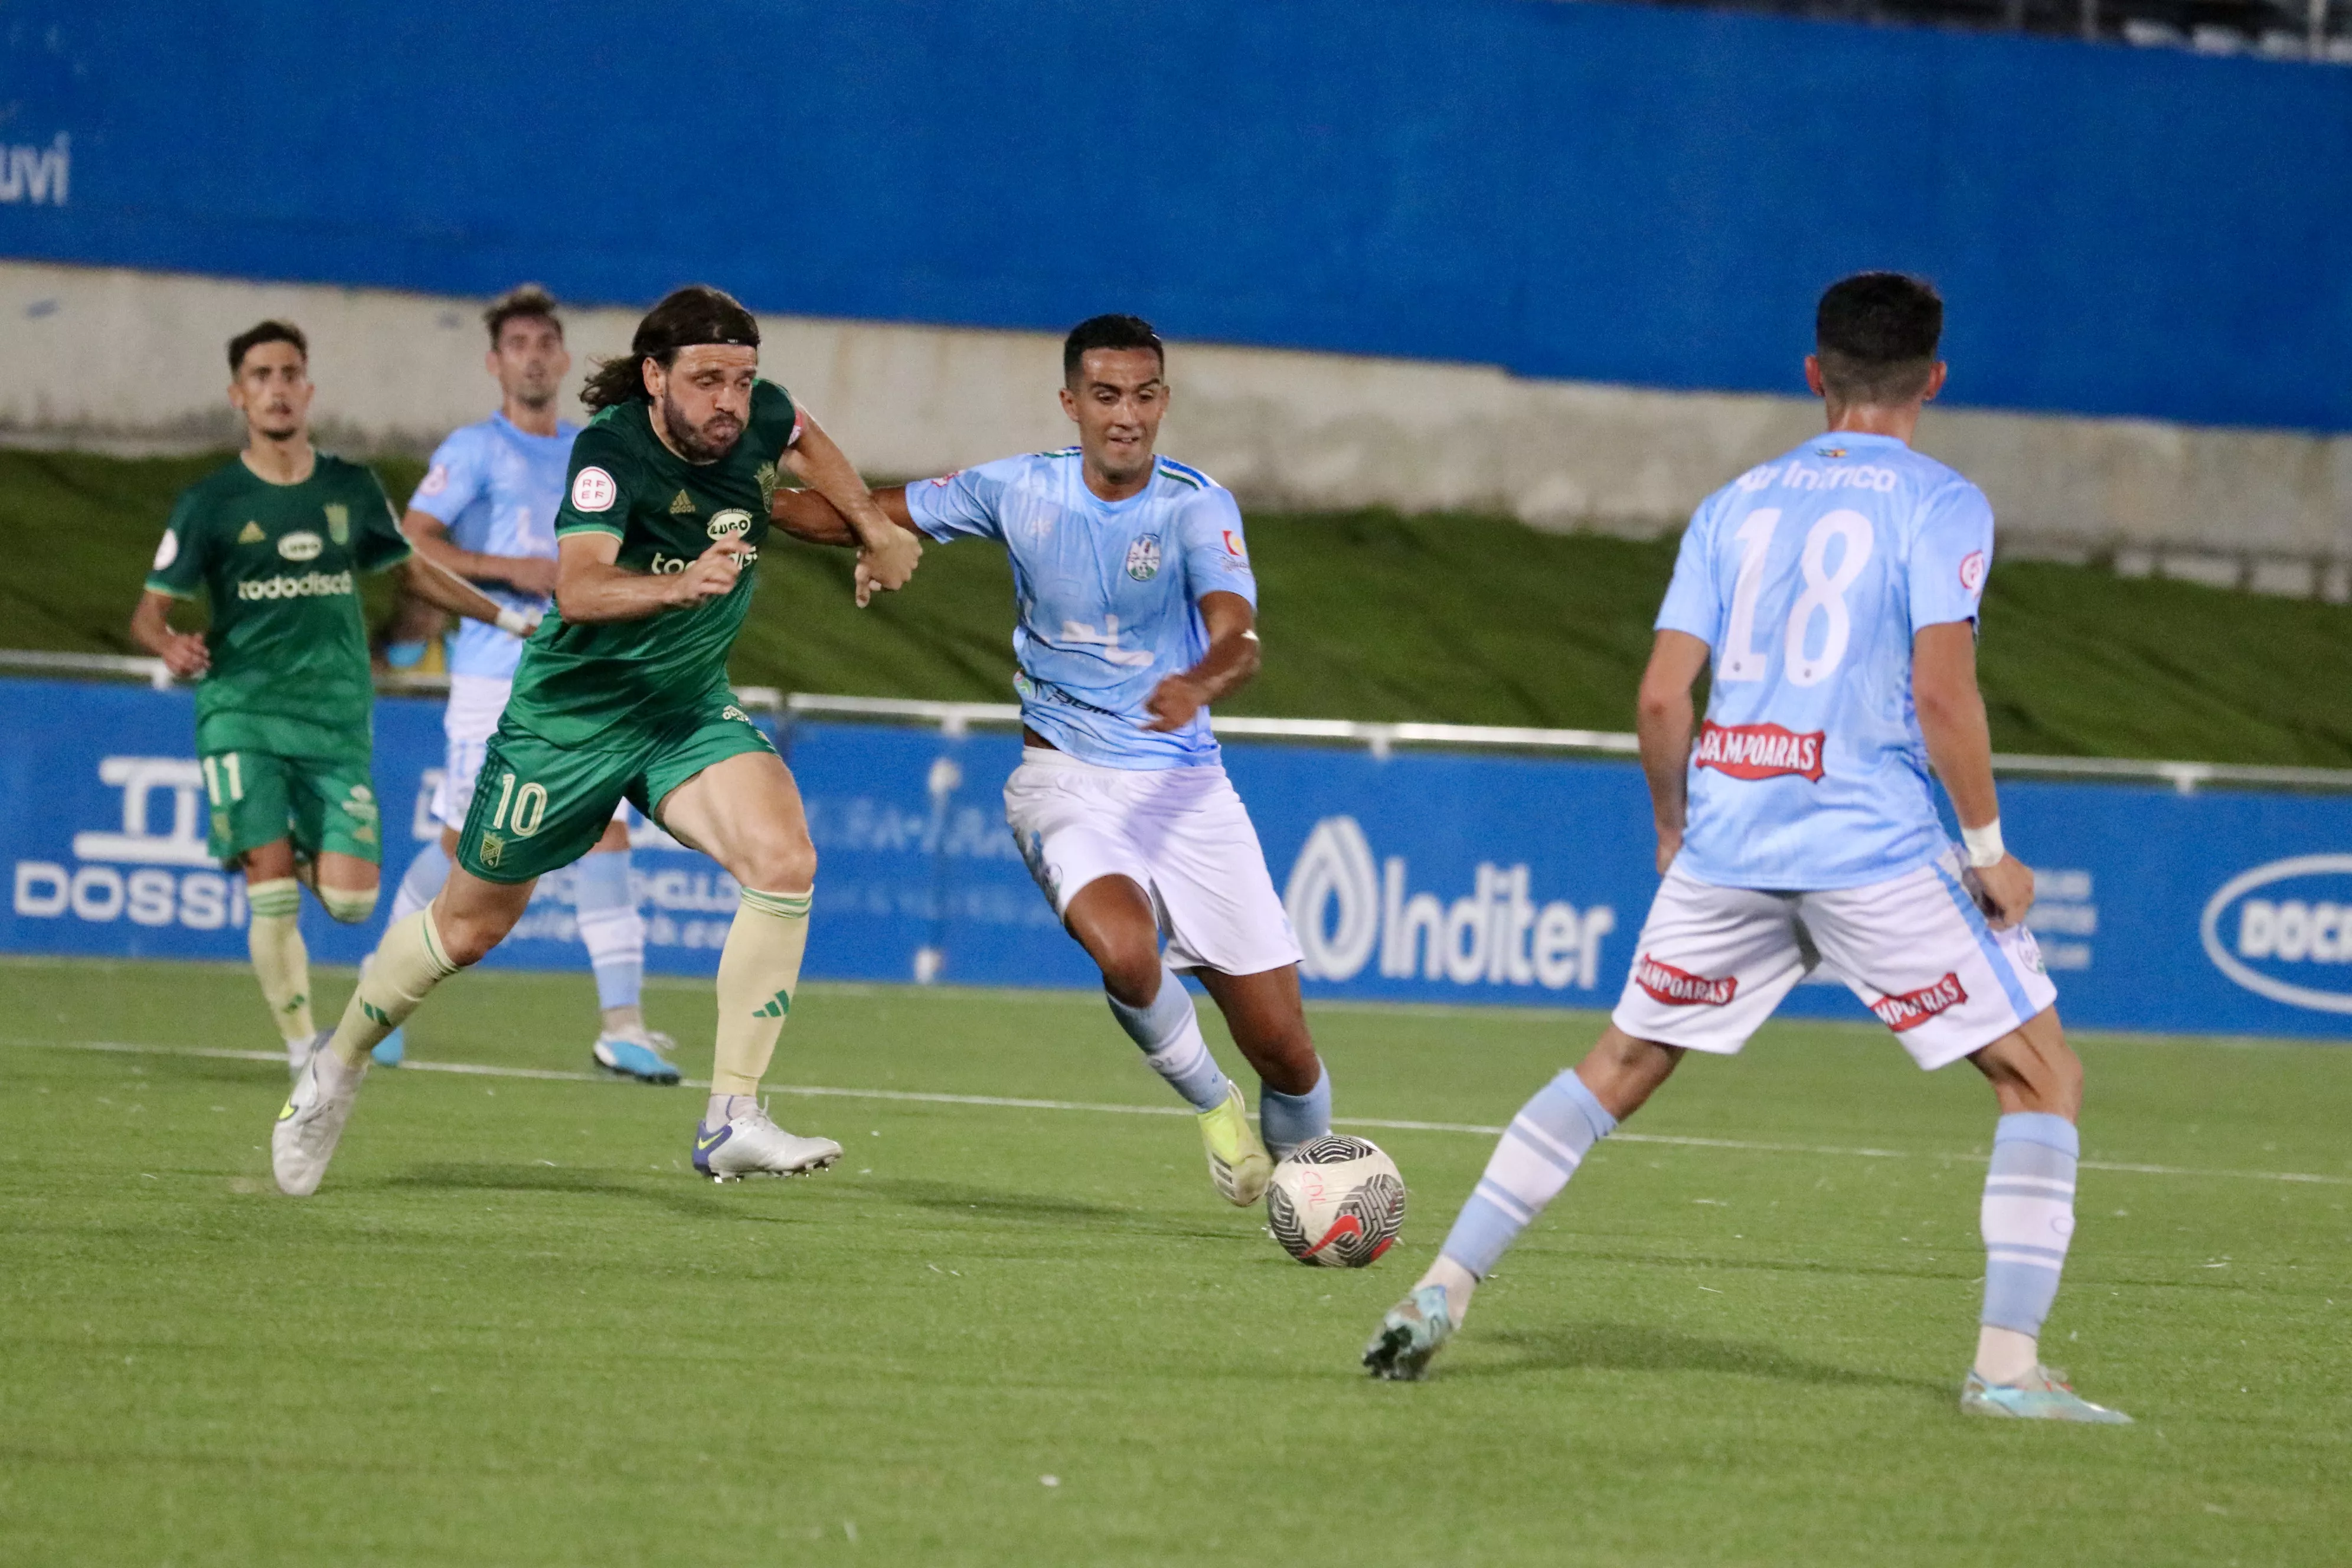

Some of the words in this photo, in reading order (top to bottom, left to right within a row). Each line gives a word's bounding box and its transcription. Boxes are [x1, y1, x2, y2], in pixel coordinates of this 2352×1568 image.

[710, 520, 749, 535] LUGO
[1717, 508, 1874, 687] 18
[203, 752, 243, 806] 11
[492, 773, 547, 837] 10
[1380, 855, 1615, 989] Inditer
